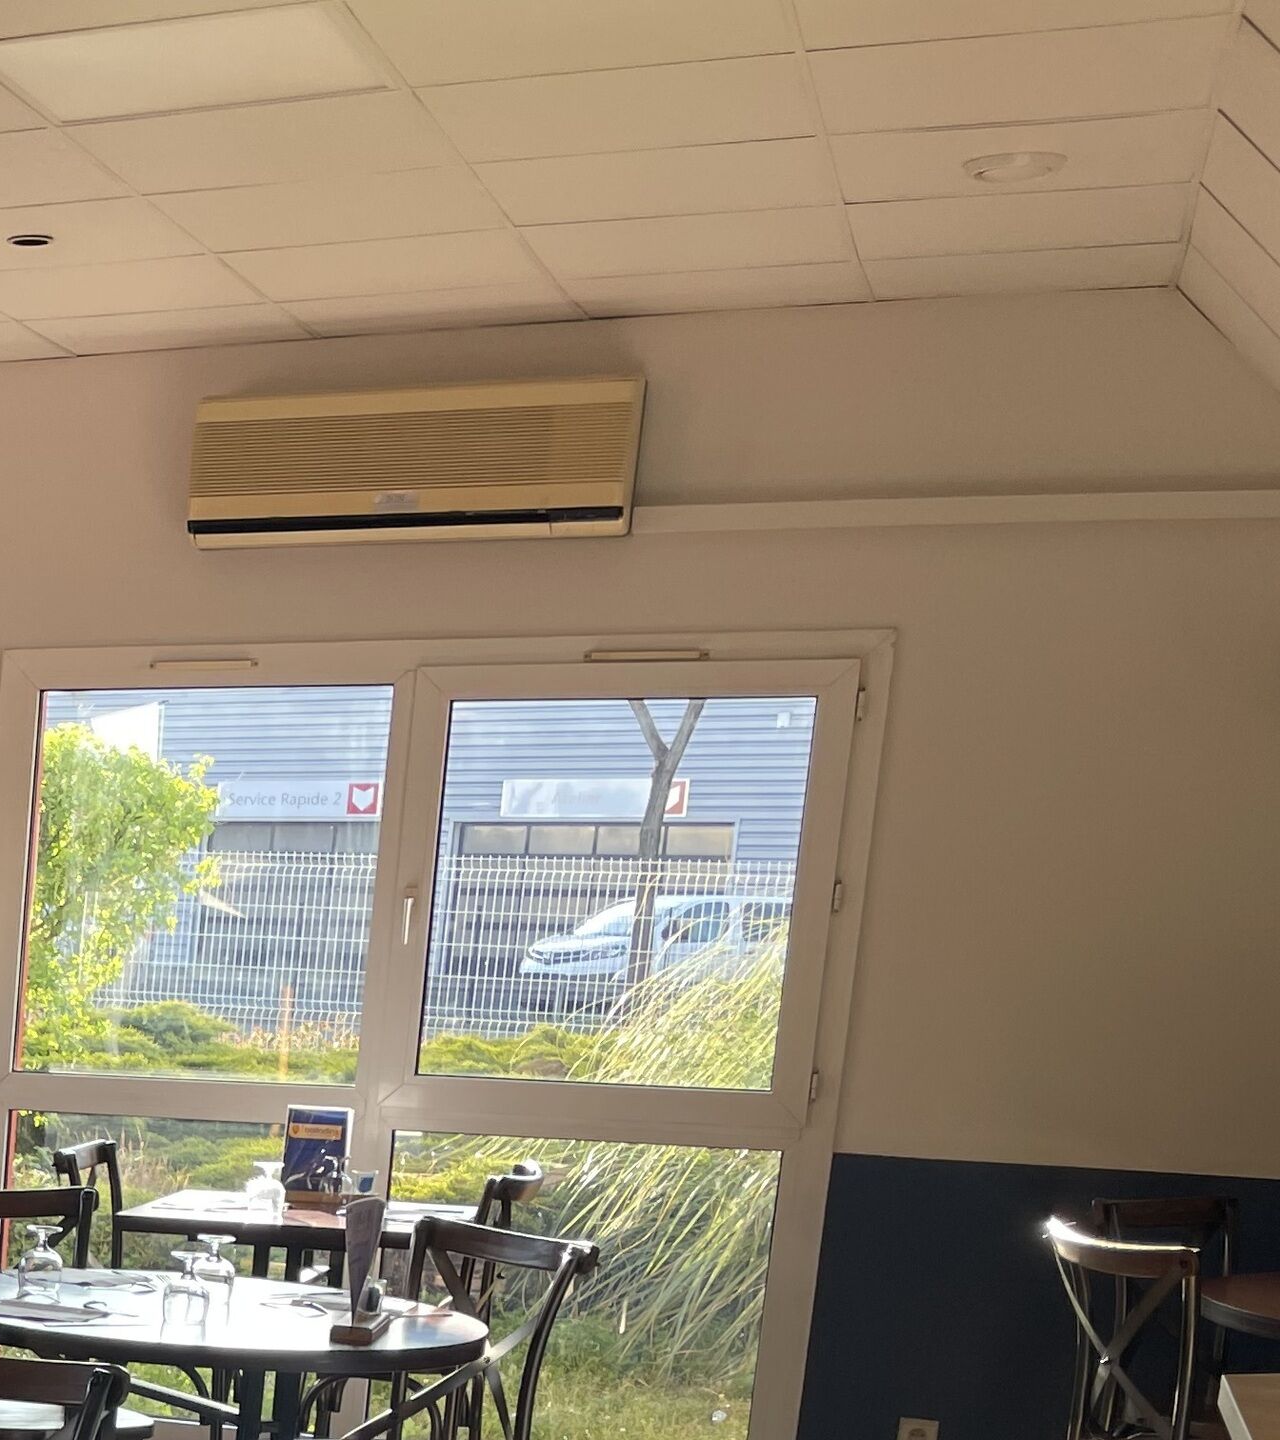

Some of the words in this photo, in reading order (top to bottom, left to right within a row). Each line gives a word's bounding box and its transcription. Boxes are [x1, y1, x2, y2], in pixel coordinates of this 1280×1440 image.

[228, 793, 276, 806] Service
[281, 793, 328, 808] Rapide
[332, 792, 342, 805] 2
